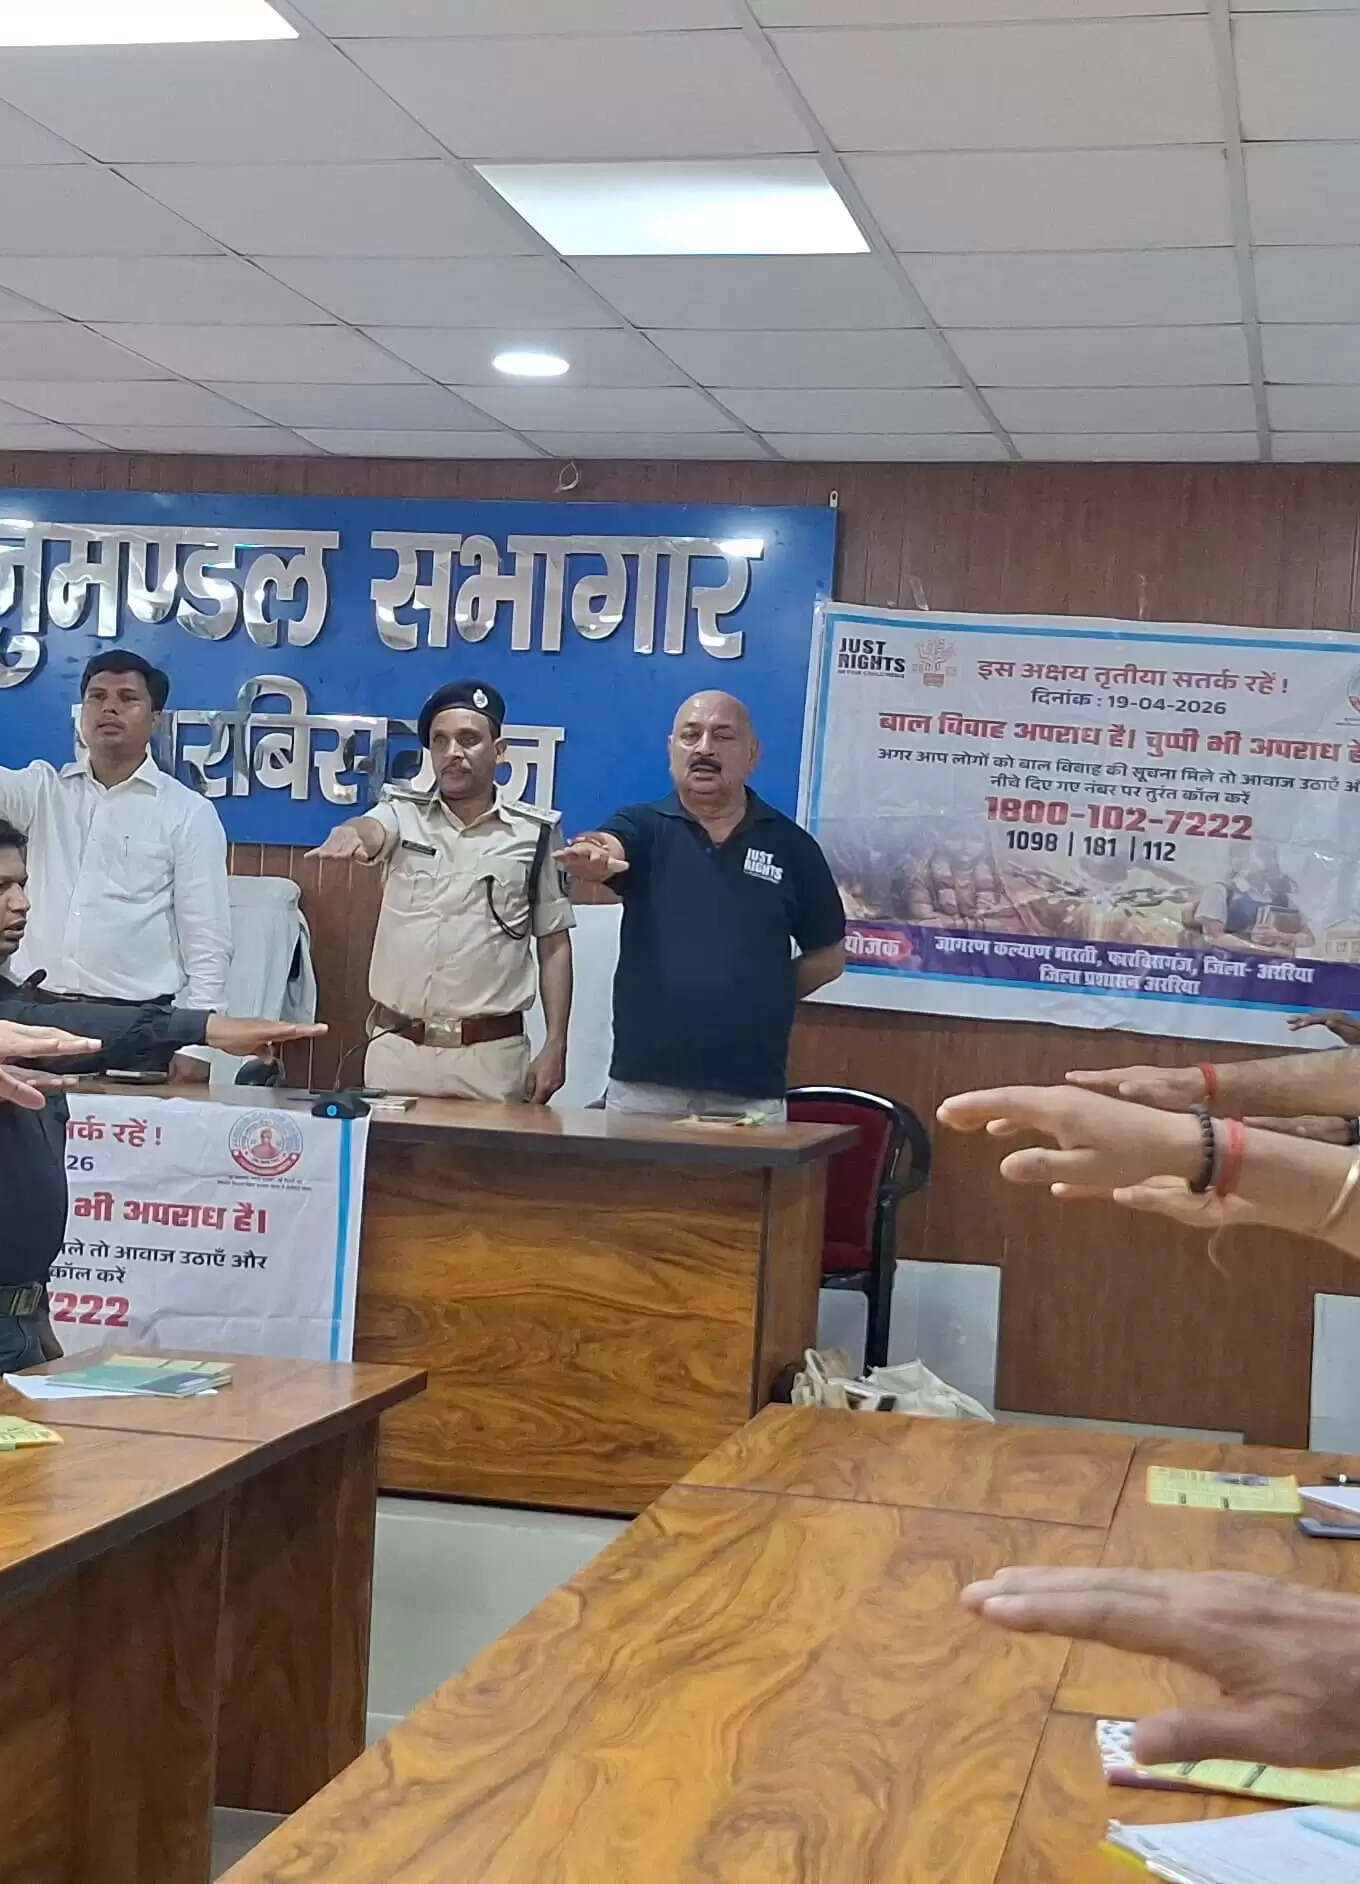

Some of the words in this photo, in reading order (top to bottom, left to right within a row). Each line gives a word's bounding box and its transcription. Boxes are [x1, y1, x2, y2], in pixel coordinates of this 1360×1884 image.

[370, 531, 766, 659] सभागार
[838, 637, 887, 655] JUST
[837, 653, 906, 673] RIGHTS
[978, 659, 1014, 680] इस
[1021, 661, 1088, 683] अक्षय
[1093, 664, 1167, 689] तृतीया
[1172, 668, 1239, 691] सतर्क
[1244, 670, 1276, 695] रहें
[1031, 686, 1092, 706] दिनांक
[1107, 695, 1227, 715] 19-04-2026
[878, 712, 932, 735] बाल
[938, 711, 1007, 739] विवाह
[1014, 722, 1103, 746] अपराध
[1145, 727, 1200, 757] चुप्पी
[1206, 731, 1243, 756] भी
[1250, 738, 1342, 763] अपराध
[877, 748, 911, 761] अगर
[916, 750, 948, 765] आप
[952, 749, 989, 767] लोगों
[993, 754, 1014, 769] को
[1019, 758, 1051, 772] बाल
[1056, 757, 1102, 776] विवाह
[1106, 760, 1128, 777] की
[1132, 765, 1176, 782] सूचना
[1181, 766, 1214, 783] मिले
[1218, 769, 1236, 785] तो
[1241, 774, 1294, 790] आवाज
[1299, 774, 1340, 791] उठाएँ
[990, 773, 1021, 789] नीचे
[1025, 774, 1052, 792] दिए
[1056, 779, 1080, 792] गए
[1084, 780, 1116, 796] नंबर
[1120, 785, 1141, 798] पर
[1145, 784, 1177, 802] तुरंत
[1181, 786, 1220, 803] कॉल
[1225, 788, 1251, 805] करें
[985, 796, 1253, 841] 1800-102-7222
[746, 847, 775, 865] JUST
[1006, 830, 1058, 852] 1098
[1083, 836, 1117, 857] 181
[1143, 841, 1177, 862] 112
[743, 859, 783, 880] RIGHTS
[844, 931, 901, 957] योजक
[934, 935, 990, 955] जागरण
[993, 941, 1052, 960] कल्याण
[1256, 962, 1315, 984] अररिया
[1039, 963, 1080, 984] जिला
[1083, 970, 1140, 990] प्रशासन
[1143, 975, 1201, 995] अररिया
[112, 1117, 148, 1148] रहें
[73, 1191, 115, 1222] भी
[123, 1199, 227, 1231] अपराध
[60, 1238, 84, 1257] ले
[89, 1239, 110, 1259] तो
[115, 1245, 175, 1264] आवाज
[180, 1246, 227, 1268] उठाएँ
[231, 1248, 268, 1270] और
[49, 1261, 91, 1282] कॉल
[96, 1264, 127, 1284] करें
[49, 1291, 131, 1328] 222
